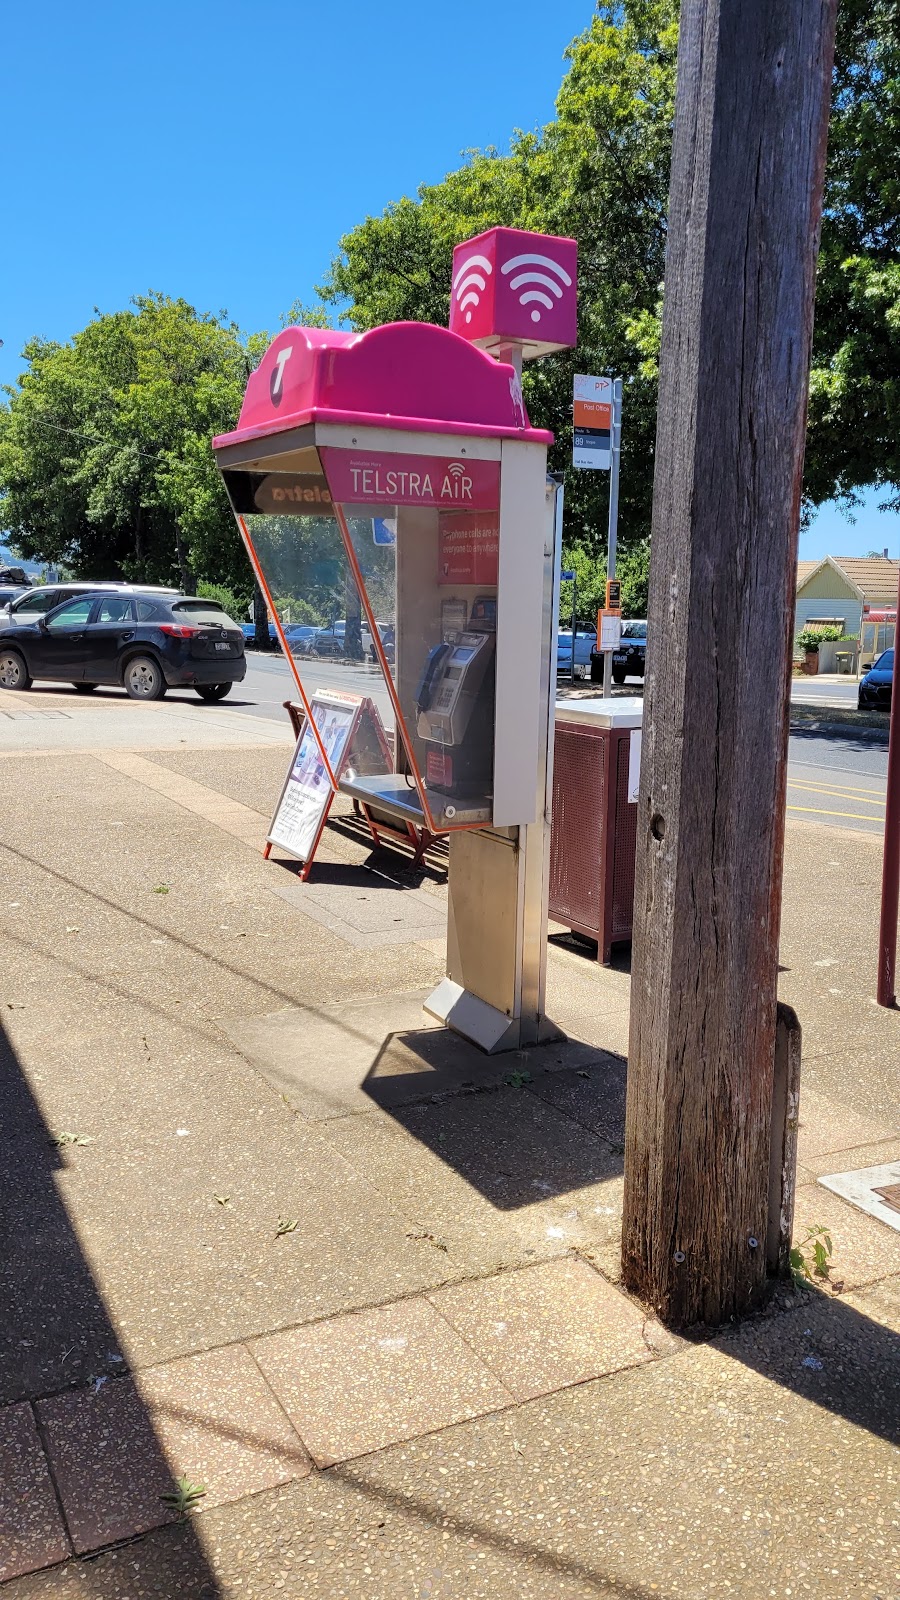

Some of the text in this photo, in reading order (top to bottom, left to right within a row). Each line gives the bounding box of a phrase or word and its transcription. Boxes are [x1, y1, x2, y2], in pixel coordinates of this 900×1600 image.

[583, 403, 610, 412] Post Office
[575, 437, 584, 446] 89
[349, 468, 434, 497] TELSTRA
[469, 527, 482, 538] calls
[482, 529, 492, 537] are
[443, 545, 465, 555] everyone
[466, 543, 473, 553] to
